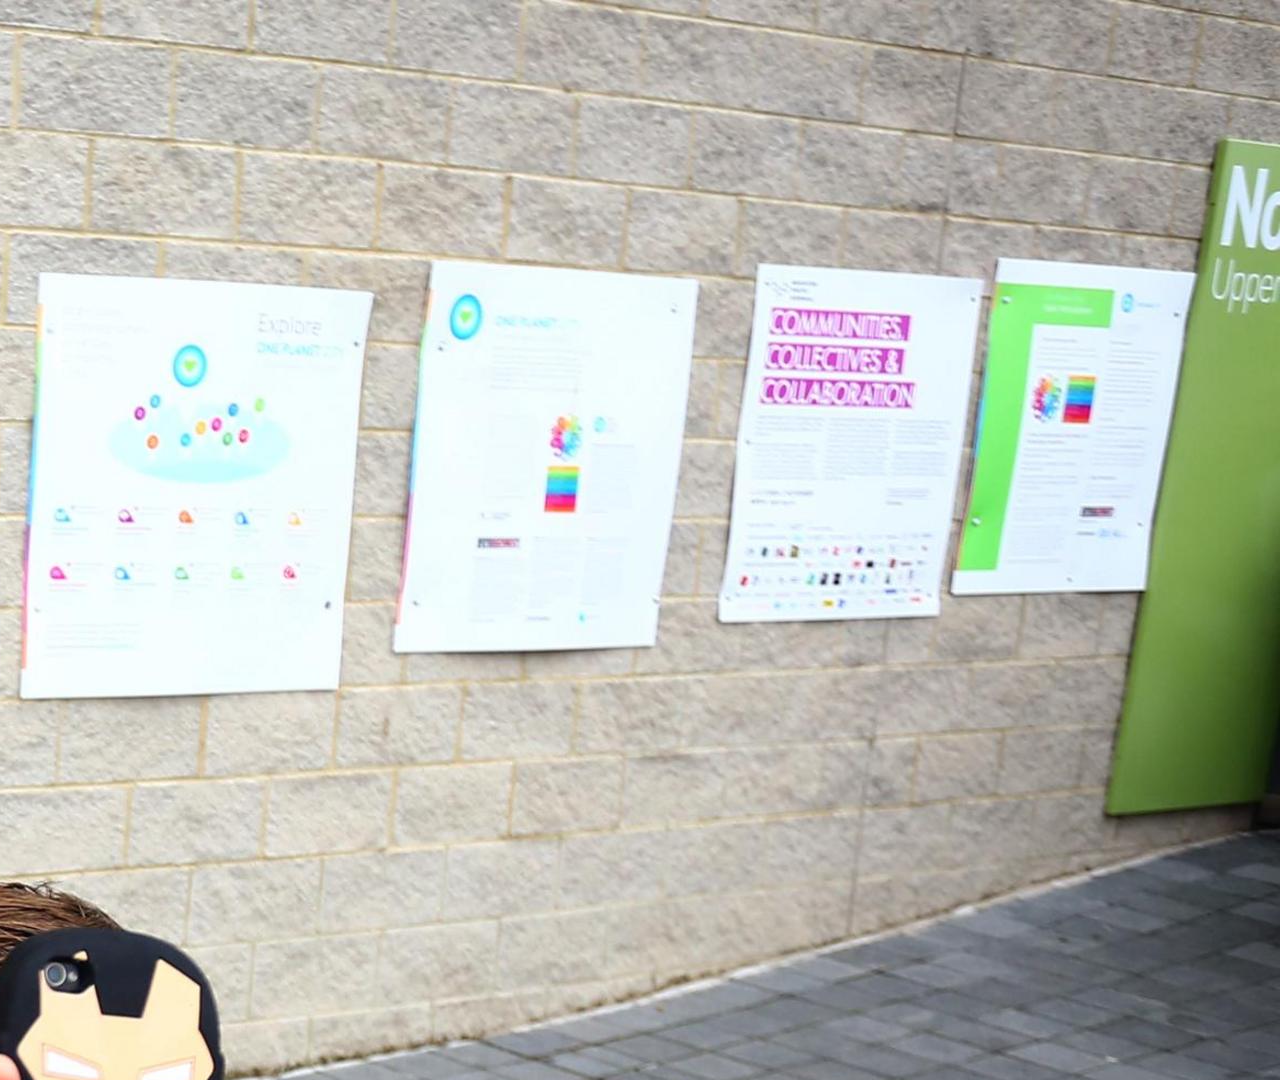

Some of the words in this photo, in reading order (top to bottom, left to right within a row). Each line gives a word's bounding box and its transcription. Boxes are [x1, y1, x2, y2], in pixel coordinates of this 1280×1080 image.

[1211, 257, 1280, 314] Upper
[257, 312, 322, 337] Explore
[766, 344, 883, 374] COLLECTIVES
[884, 349, 900, 374] &
[760, 378, 913, 408] COLLABORATION
